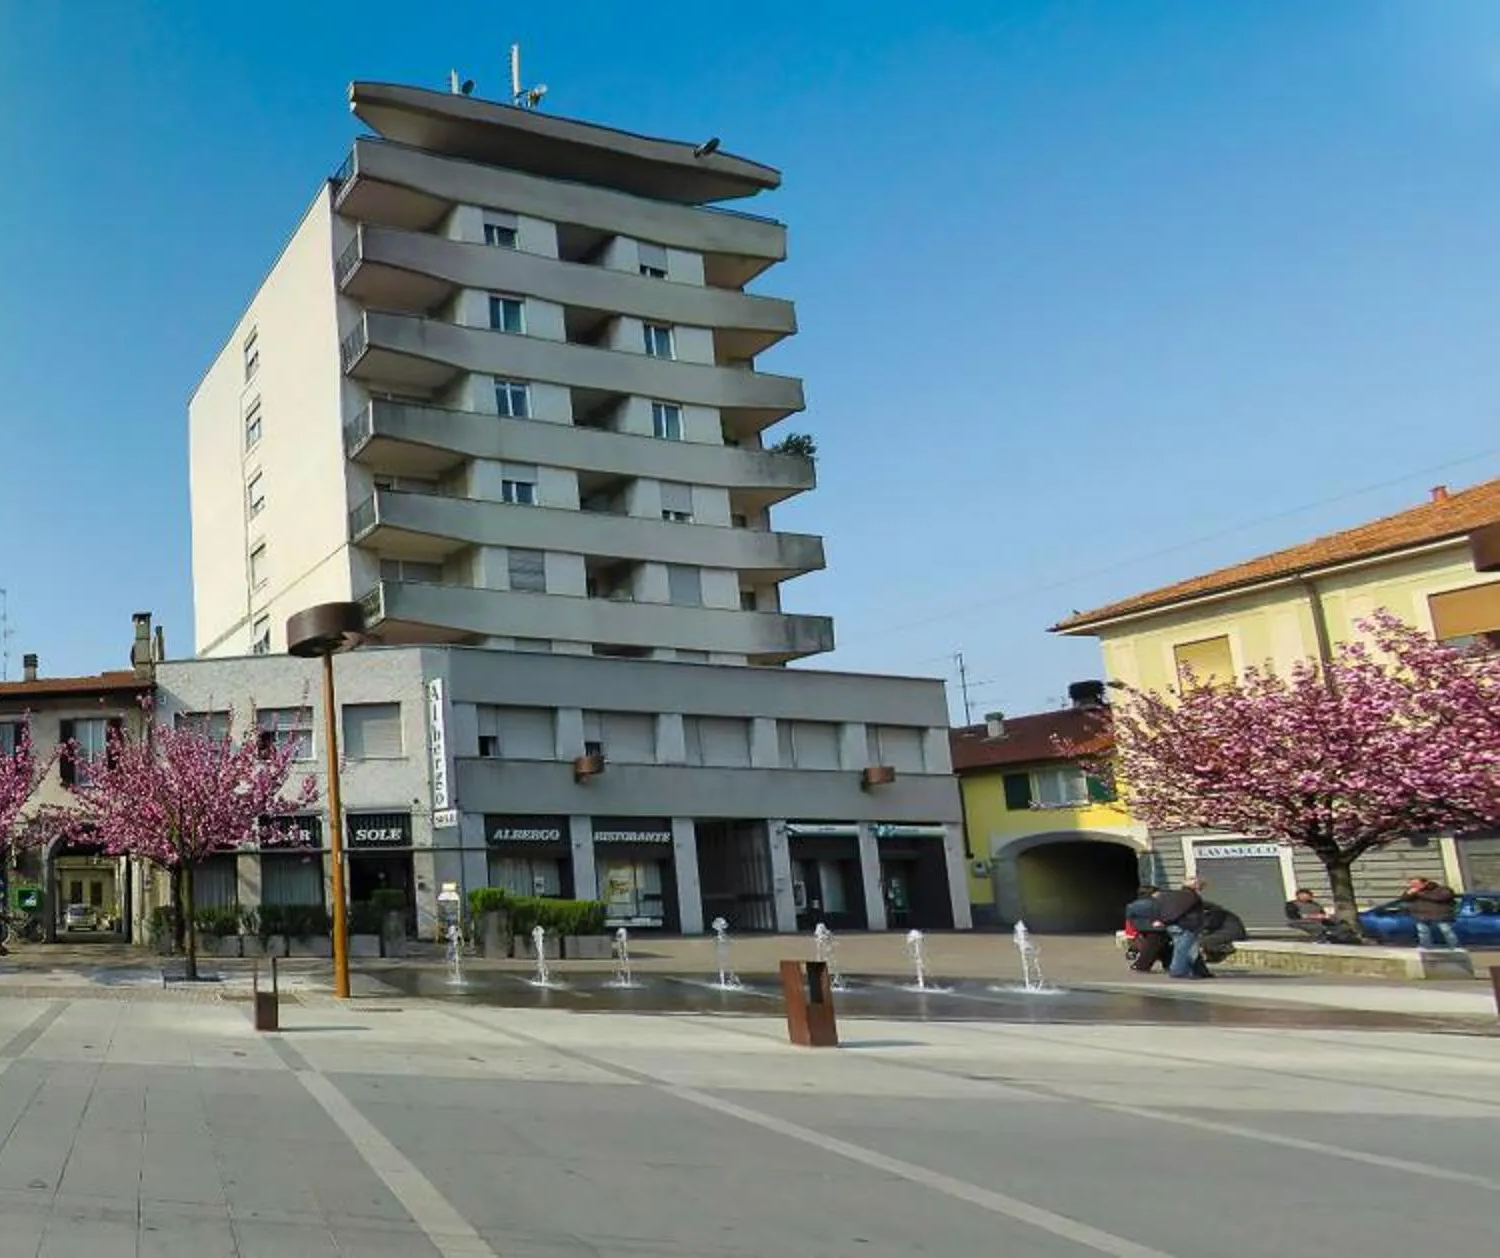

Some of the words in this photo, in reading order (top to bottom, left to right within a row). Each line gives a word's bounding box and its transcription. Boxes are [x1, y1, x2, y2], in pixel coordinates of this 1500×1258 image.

[355, 828, 402, 842] SOLE
[493, 828, 561, 842] ALBERGO
[593, 831, 671, 843] RISTORANTE
